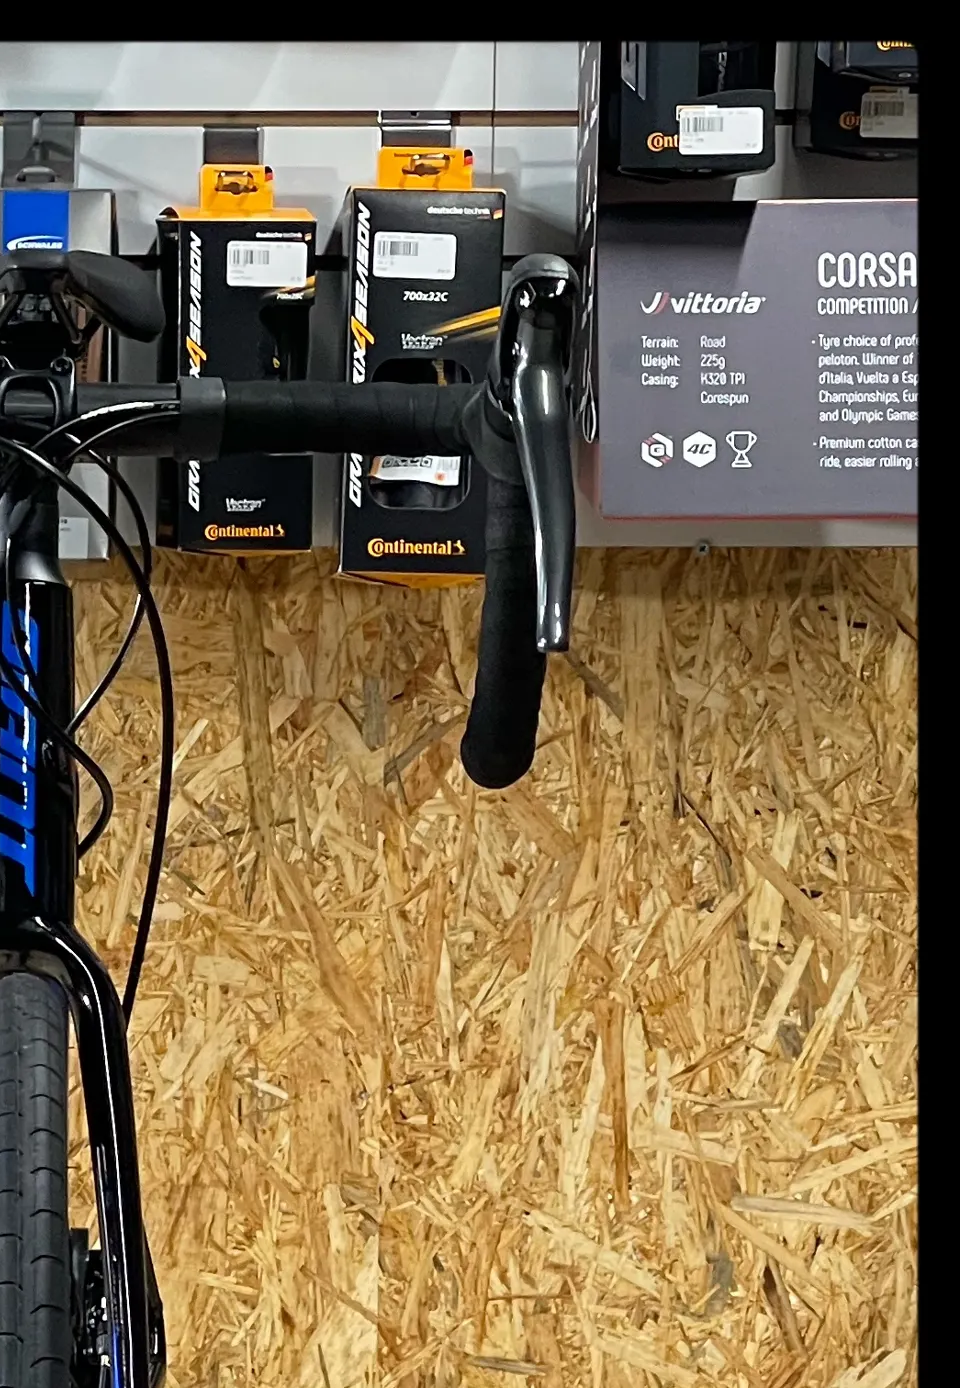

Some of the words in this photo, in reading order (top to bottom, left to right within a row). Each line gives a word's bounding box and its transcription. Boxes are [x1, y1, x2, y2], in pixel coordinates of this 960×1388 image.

[818, 251, 918, 288] CORSA
[403, 291, 449, 302] 700x32C
[670, 291, 762, 314] vittoria
[817, 297, 909, 315] COMPETITION
[641, 335, 680, 349] Terrain:
[700, 335, 727, 349] Road
[818, 334, 841, 350] Tyre
[843, 334, 878, 347] choice
[880, 333, 892, 347] of
[894, 333, 918, 349] prof
[641, 353, 681, 370] Weight:
[700, 353, 726, 371] 225g
[818, 353, 860, 368] peloton.
[862, 352, 901, 366] Winner
[902, 352, 914, 366] of
[641, 373, 680, 389] Casing:
[700, 372, 727, 386] K320
[730, 372, 746, 386] TPI
[856, 371, 890, 384] Vuelta
[892, 374, 899, 384] a
[700, 391, 750, 406] Corespun
[819, 389, 900, 405] Championships,
[819, 408, 839, 422] and
[841, 408, 884, 425] Olympic
[819, 436, 866, 450] Premium
[867, 437, 902, 450] cotton
[819, 455, 842, 469] ride,
[844, 456, 877, 468] easier
[879, 454, 913, 470] rolling
[205, 524, 274, 541] Continental
[367, 538, 452, 557] Continental
